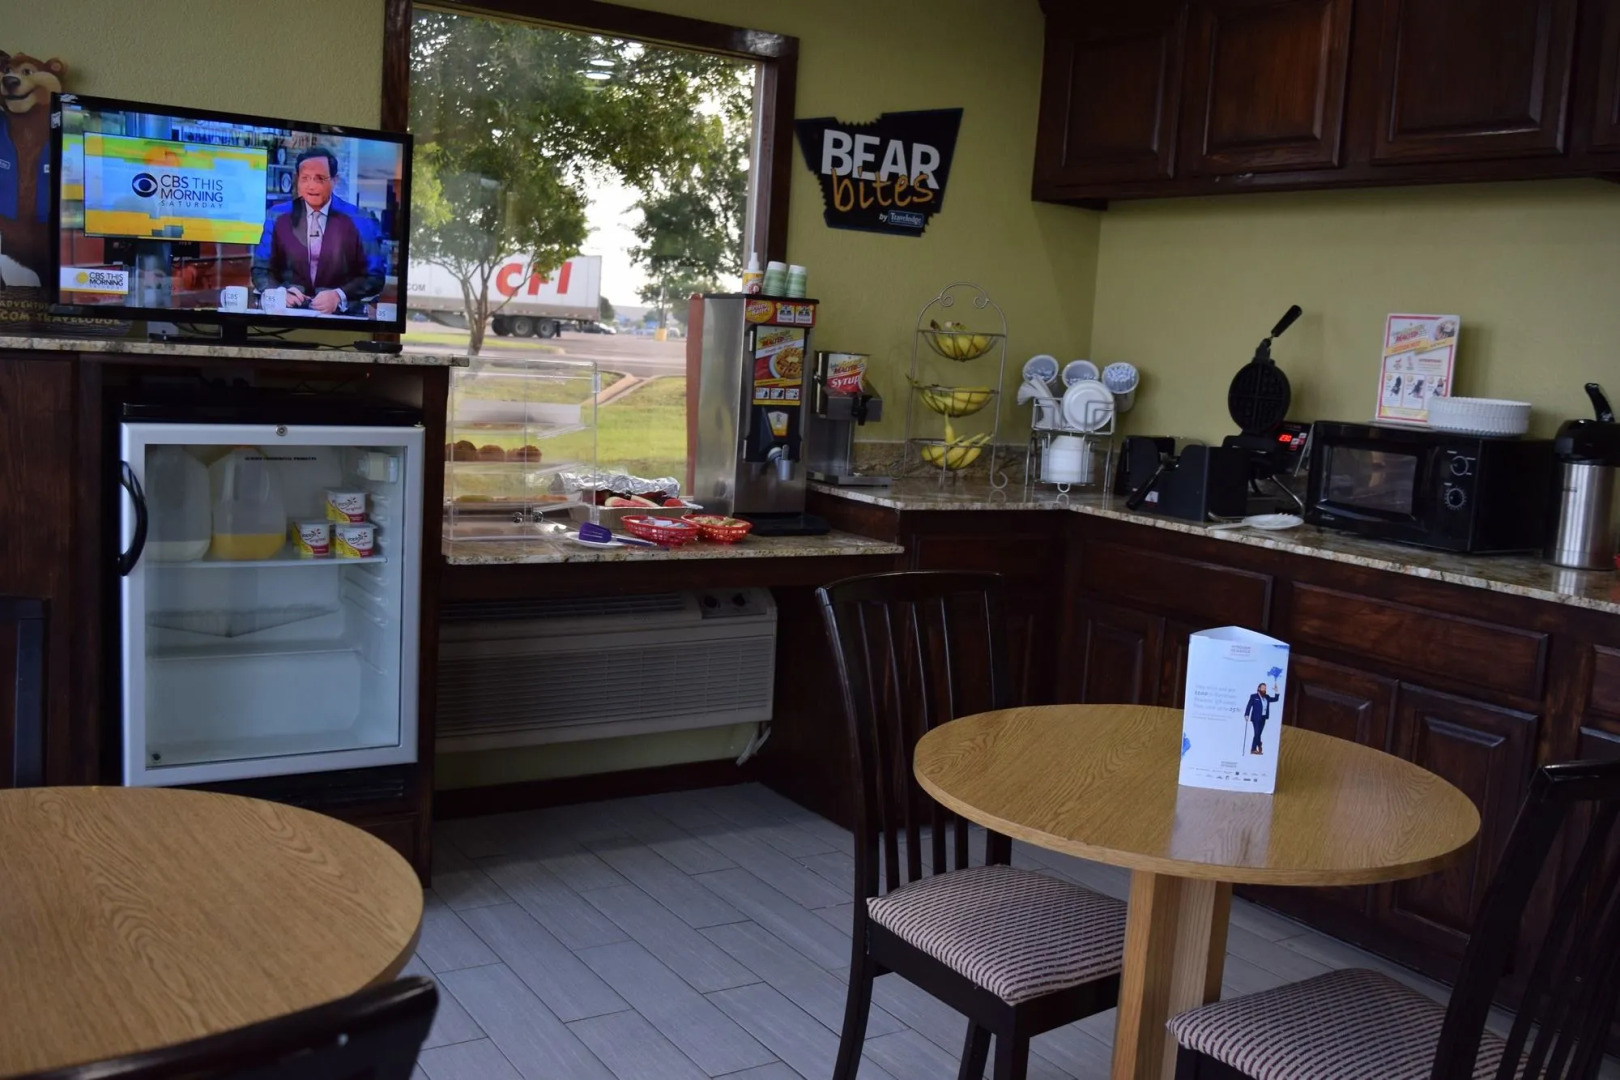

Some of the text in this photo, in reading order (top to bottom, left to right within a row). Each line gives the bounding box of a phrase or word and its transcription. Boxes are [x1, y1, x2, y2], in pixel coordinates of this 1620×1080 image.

[821, 128, 941, 189] BEAR
[160, 174, 224, 192] CBS THIS
[830, 165, 934, 212] bites
[160, 188, 224, 203] MORNING
[159, 199, 223, 209] SATURDAY
[879, 213, 888, 222] by
[89, 271, 124, 281] CBS THIS
[89, 279, 124, 287] MORNING
